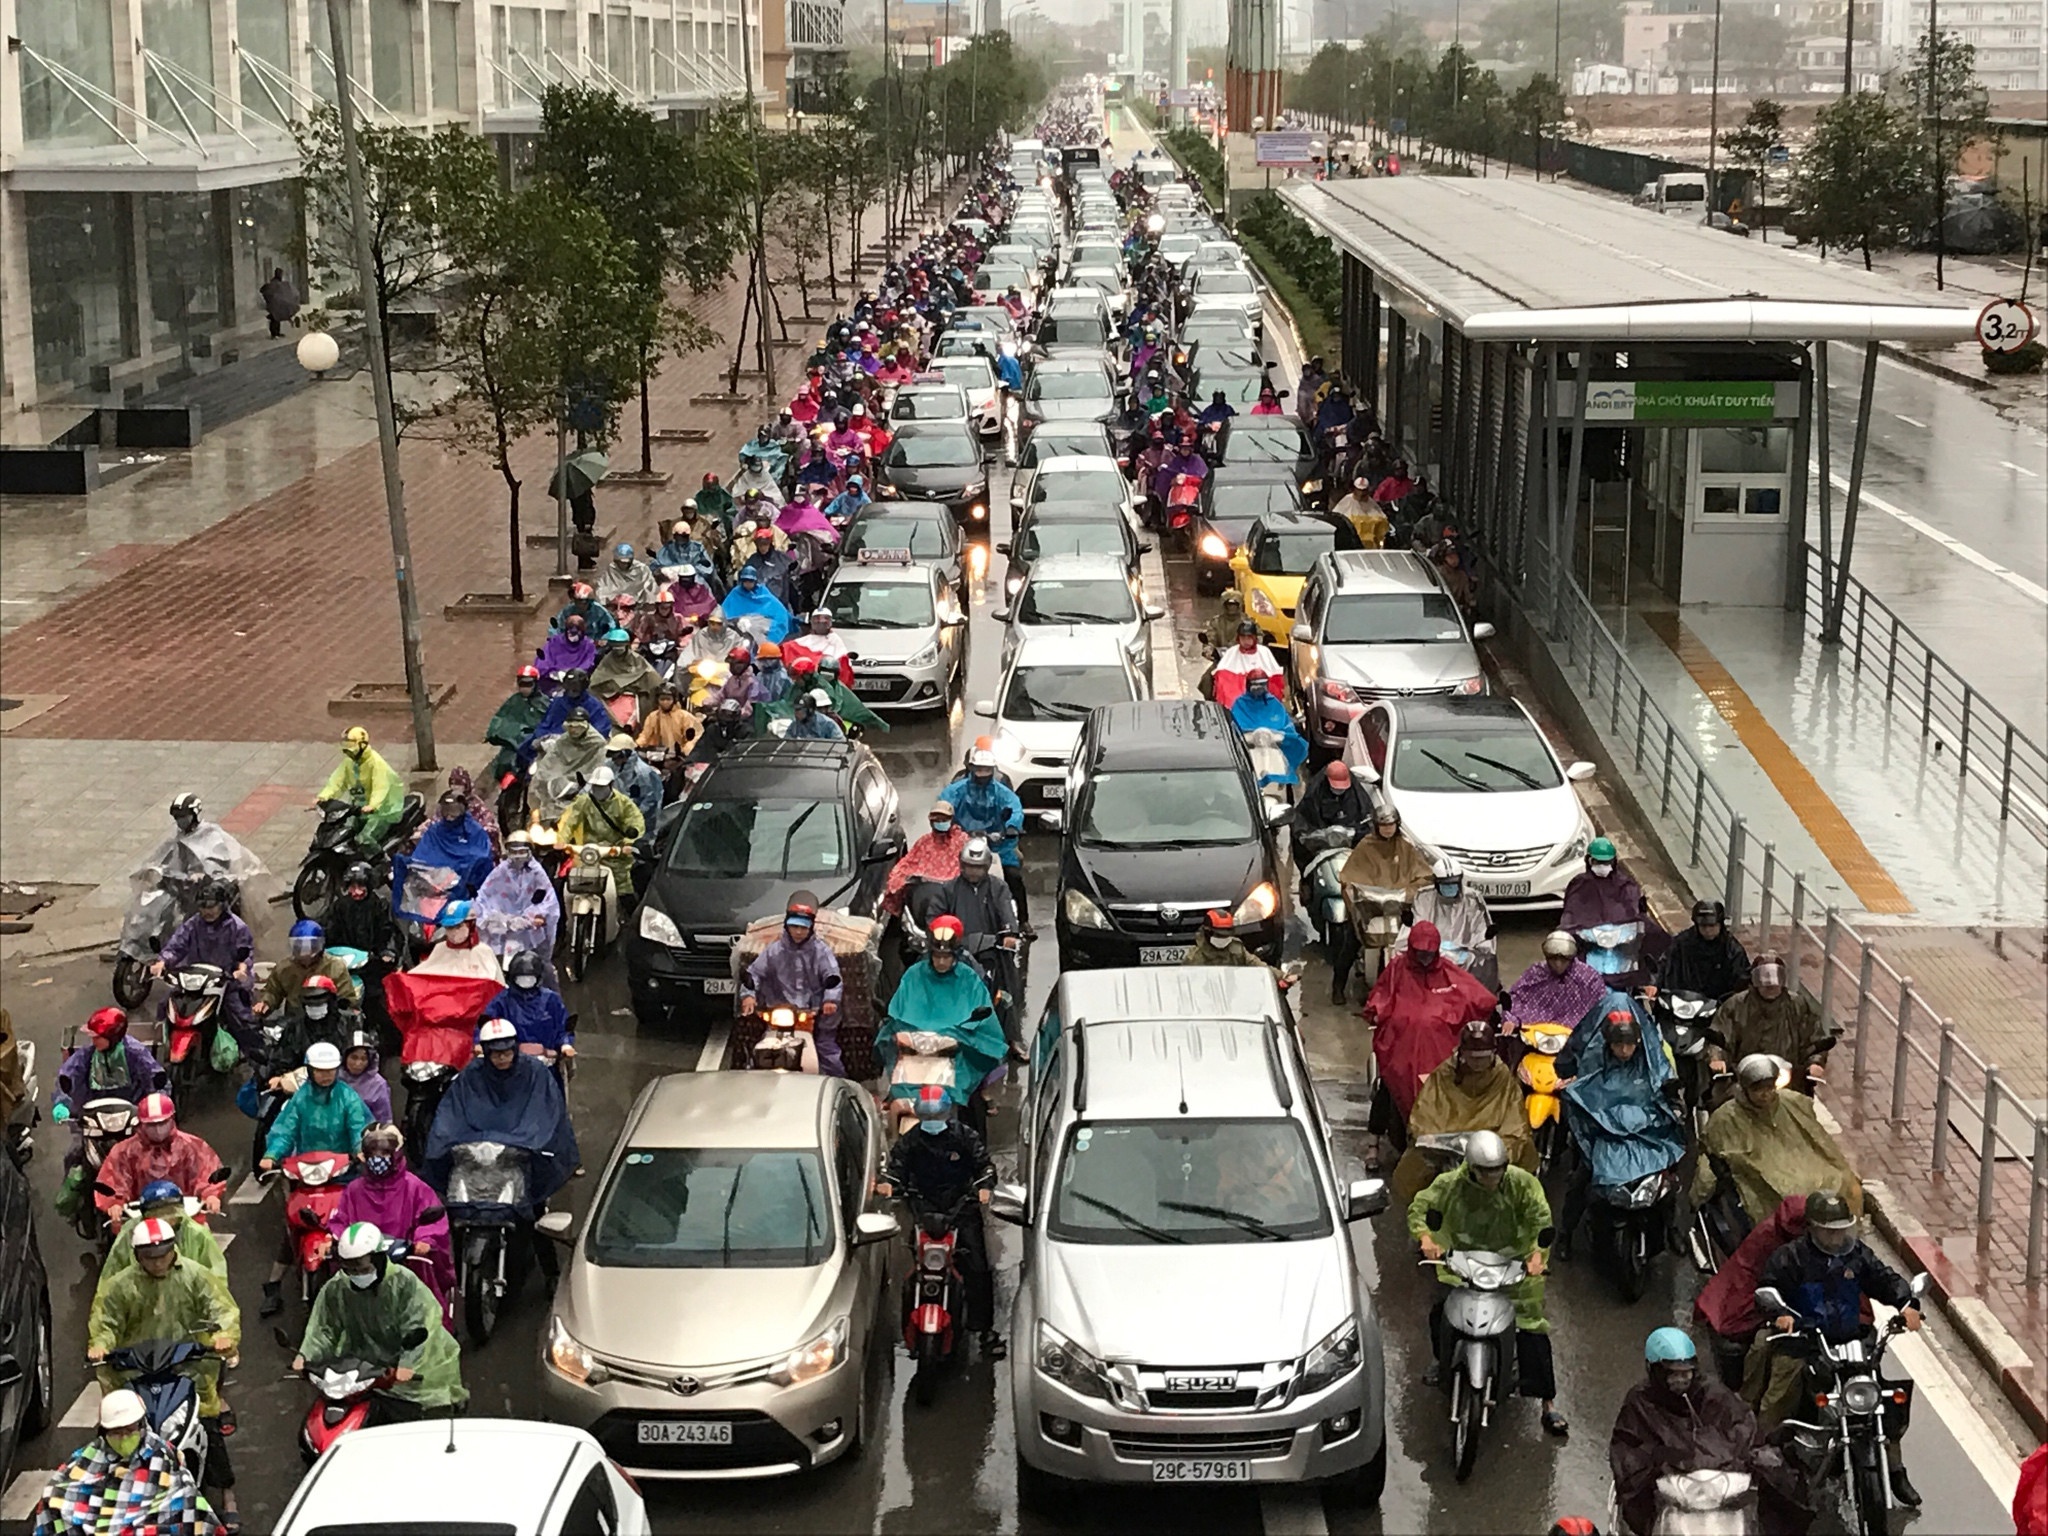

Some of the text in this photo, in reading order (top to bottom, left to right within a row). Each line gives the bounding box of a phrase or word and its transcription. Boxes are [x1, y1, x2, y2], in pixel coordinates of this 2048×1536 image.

[1584, 400, 1612, 410] ANOI
[1725, 395, 1749, 407] DUY
[1168, 1376, 1235, 1391] ISUZU
[1154, 1461, 1247, 1480] 29C-579.61
